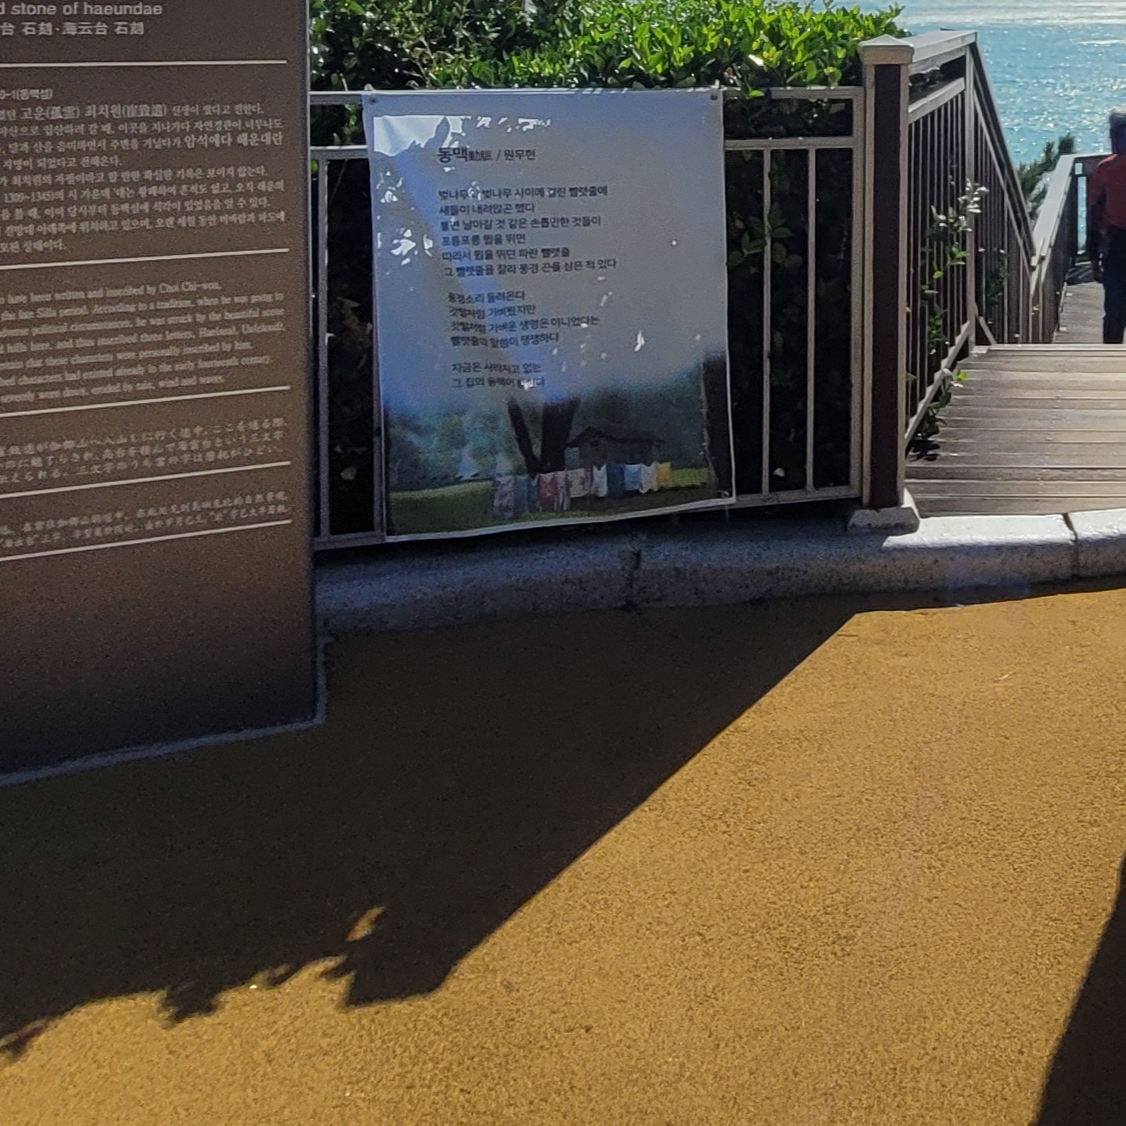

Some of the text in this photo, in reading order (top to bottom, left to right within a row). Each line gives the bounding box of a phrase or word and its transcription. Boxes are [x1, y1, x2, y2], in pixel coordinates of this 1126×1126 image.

[10, 2, 57, 15] stone
[62, 2, 78, 15] of
[84, 2, 163, 15] haeundae
[184, 133, 233, 149] 암석에다
[504, 149, 536, 161] 원무현
[444, 267, 454, 277] 그
[597, 258, 617, 269] 있다
